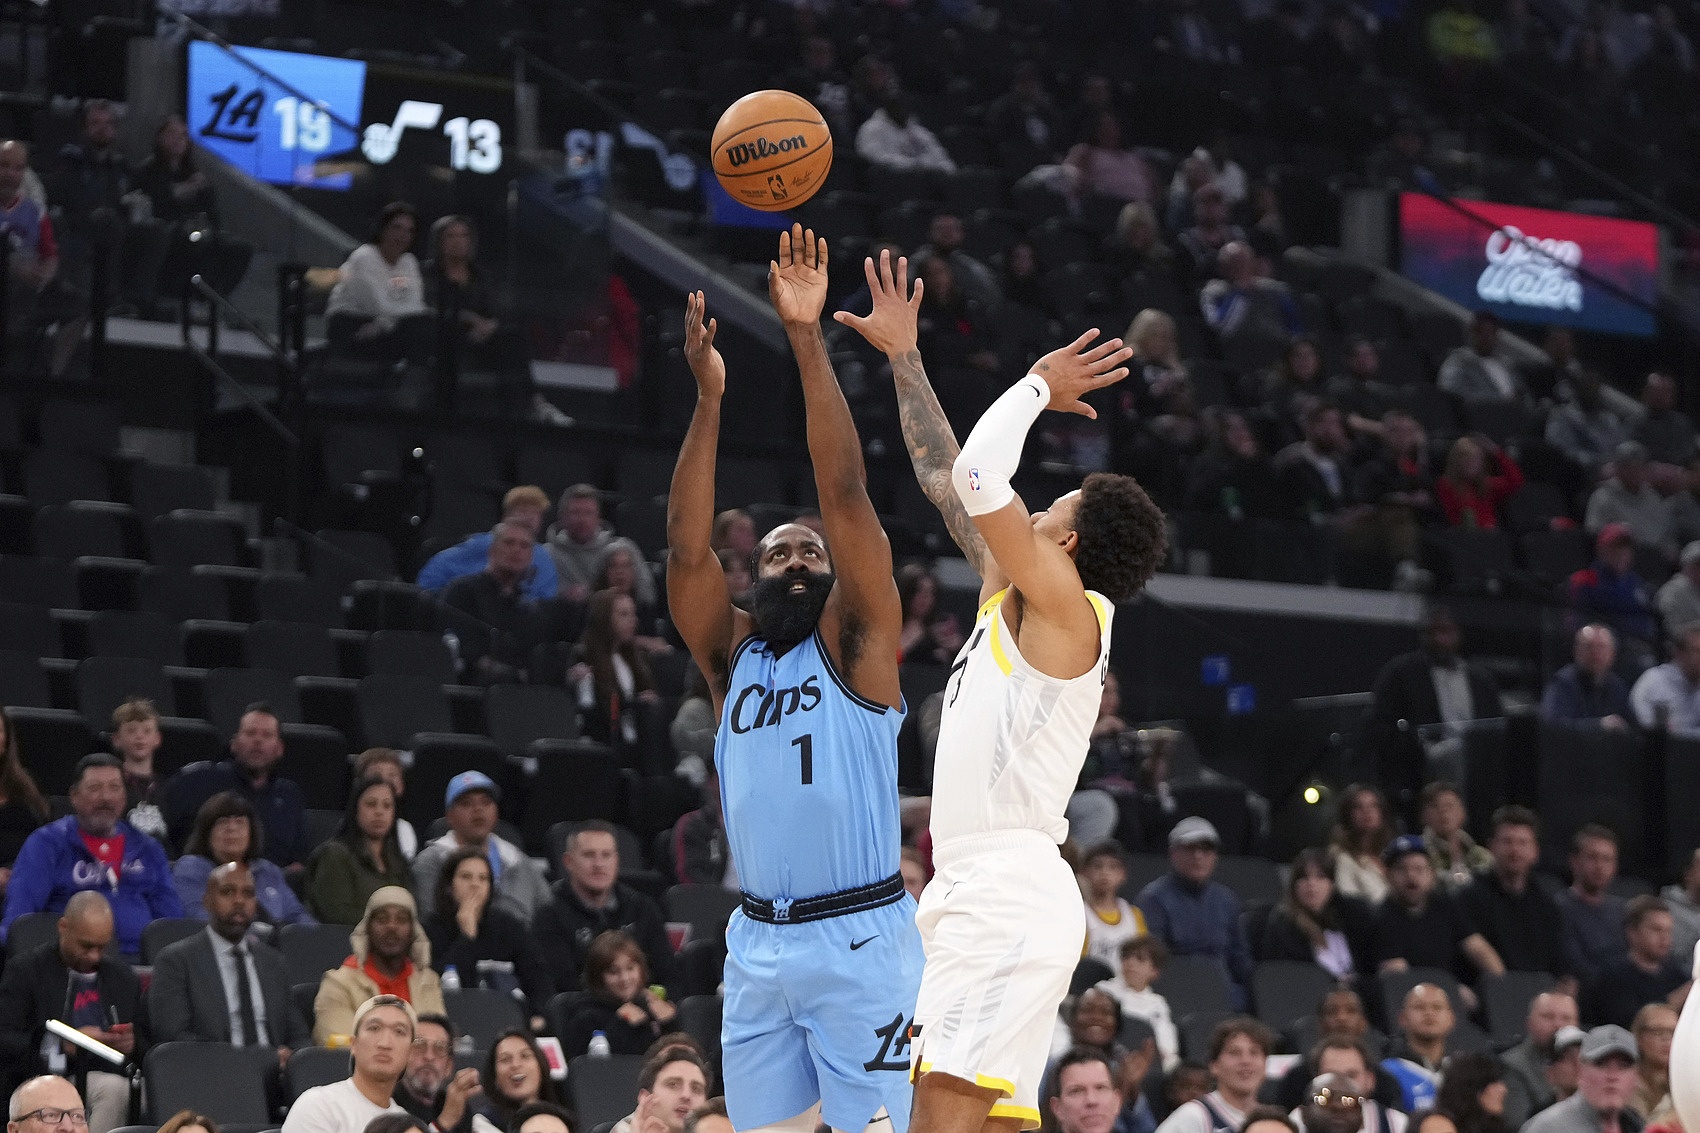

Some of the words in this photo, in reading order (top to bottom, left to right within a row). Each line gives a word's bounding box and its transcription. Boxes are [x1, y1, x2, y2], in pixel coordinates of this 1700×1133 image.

[201, 83, 266, 142] LA
[274, 97, 332, 153] 19
[444, 117, 502, 174] 13
[726, 135, 808, 168] Wilson
[791, 734, 813, 785] 1
